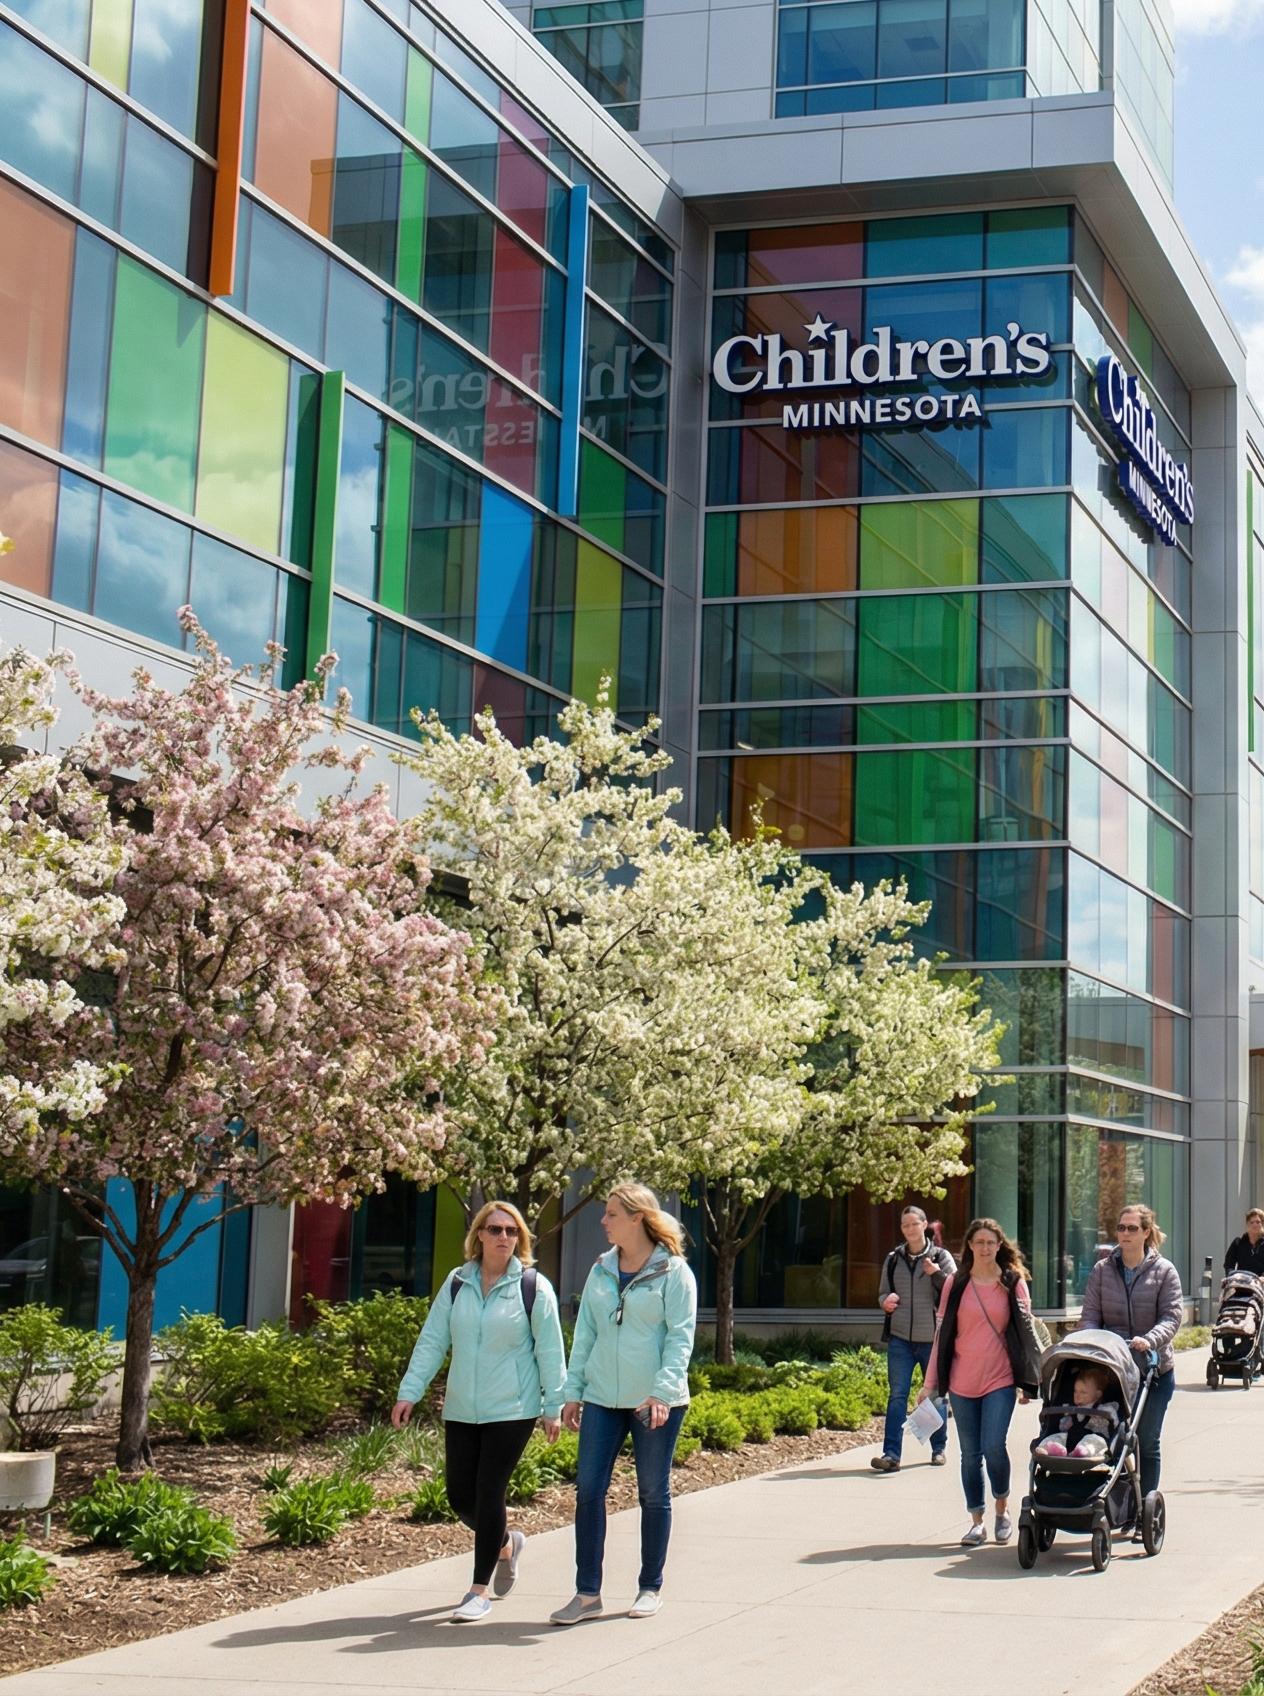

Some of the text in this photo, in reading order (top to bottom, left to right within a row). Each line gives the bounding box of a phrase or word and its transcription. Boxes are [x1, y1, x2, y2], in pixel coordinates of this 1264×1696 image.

[713, 313, 1049, 394] Children's
[782, 394, 982, 428] MINNESOTA
[1108, 355, 1194, 525] Children's
